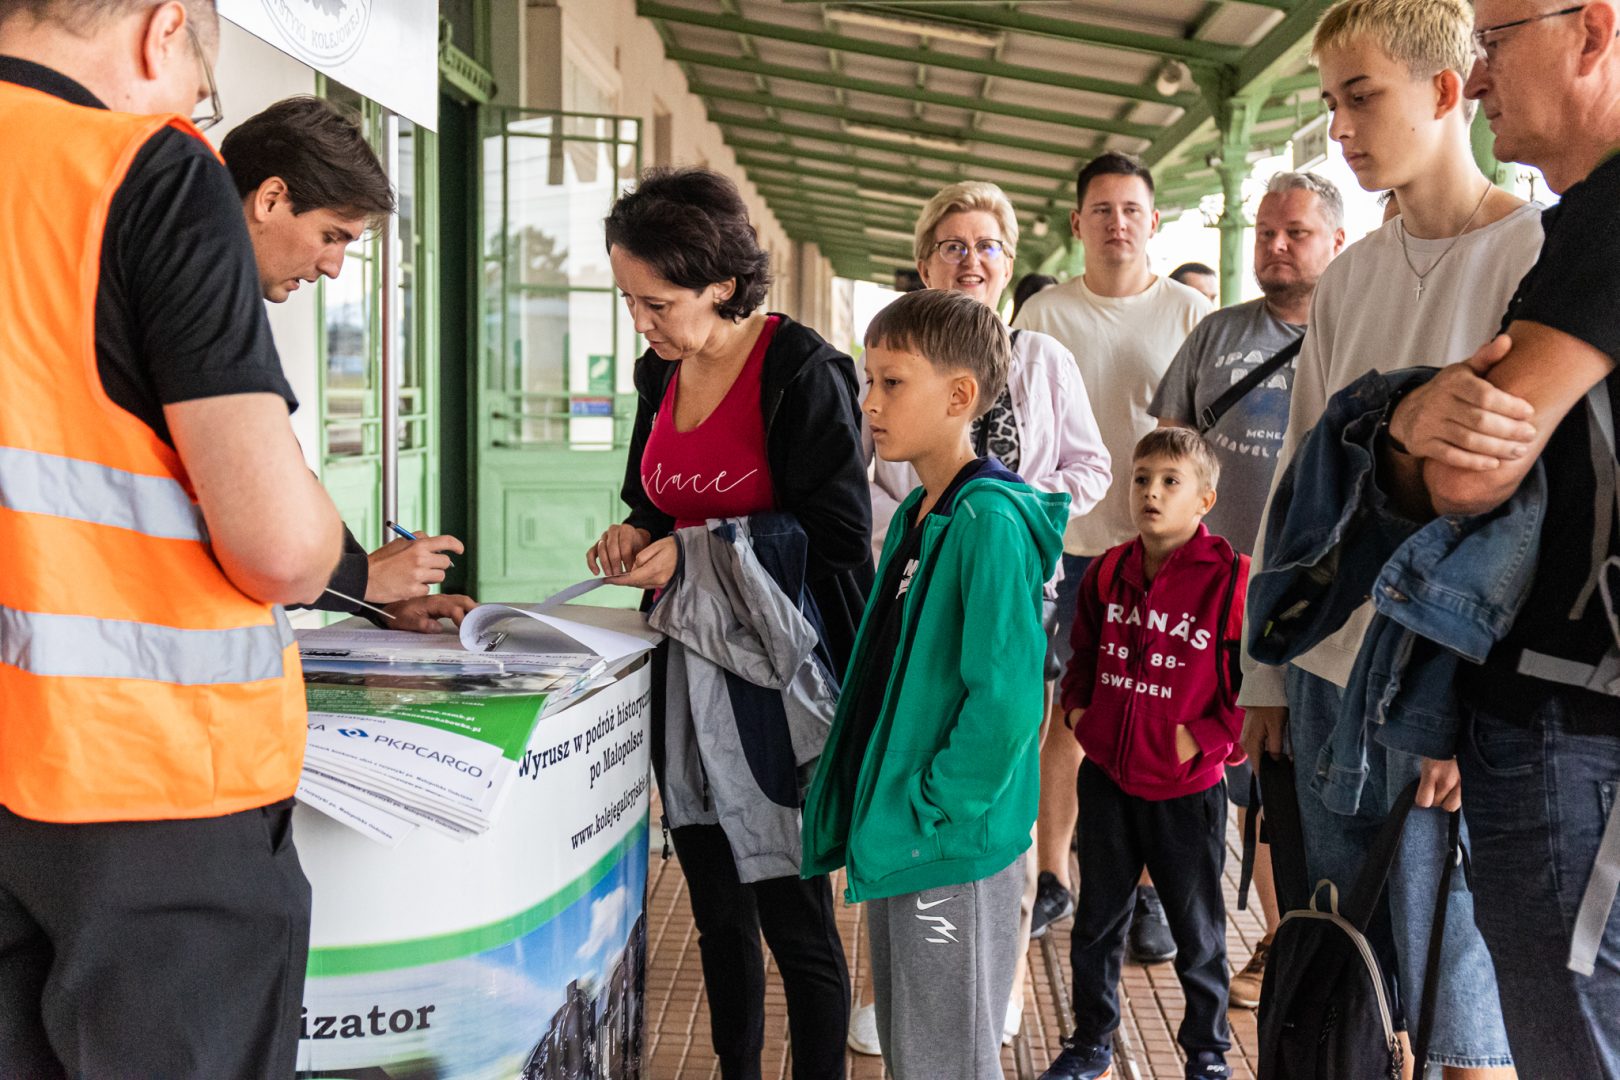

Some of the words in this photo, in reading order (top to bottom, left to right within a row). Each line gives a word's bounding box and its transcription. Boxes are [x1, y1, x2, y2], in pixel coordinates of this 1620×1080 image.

[311, 8, 360, 49] KOLEJOWEJ
[641, 462, 758, 494] race
[1107, 603, 1212, 650] RANÄS
[1101, 672, 1172, 699] SWEDEN
[519, 740, 570, 780] Wyrusz
[574, 734, 583, 753] w
[586, 708, 615, 754] podróż
[590, 761, 601, 789] po
[603, 729, 644, 773] Małopolsce
[299, 1004, 436, 1040] izator
